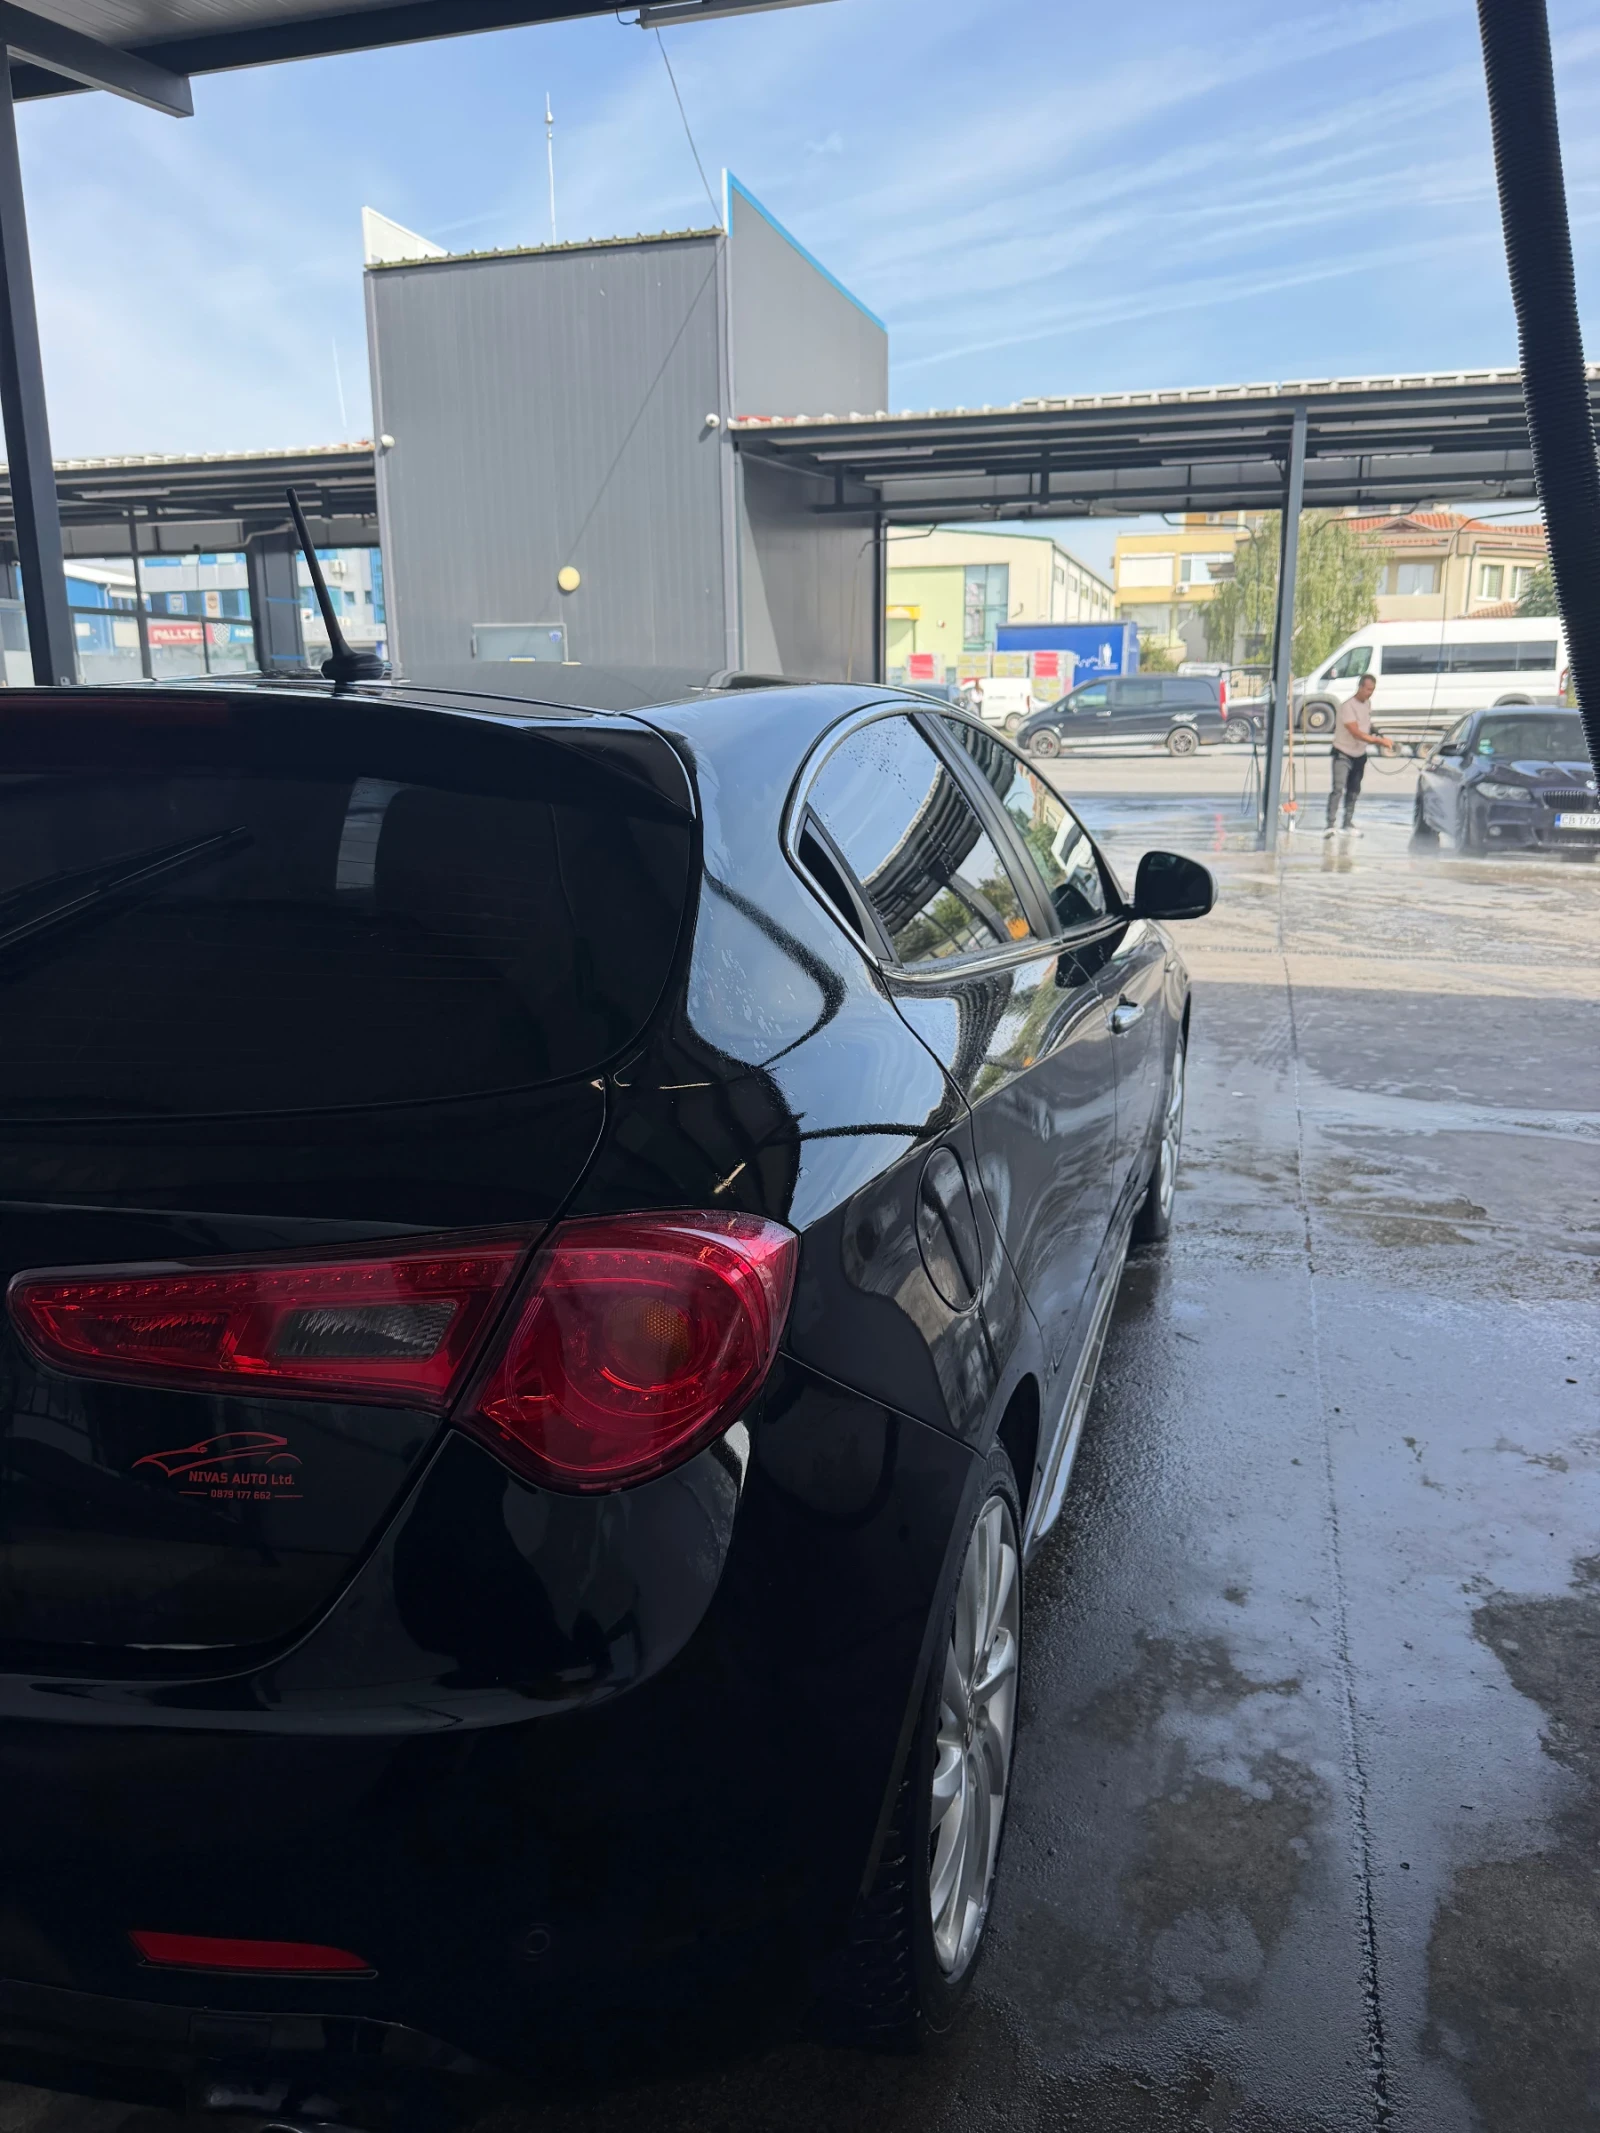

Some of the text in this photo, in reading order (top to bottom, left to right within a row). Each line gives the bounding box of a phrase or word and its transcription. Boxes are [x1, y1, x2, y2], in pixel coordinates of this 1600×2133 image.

[188, 1471, 295, 1485] NIVAS AUTO Ltd.
[210, 1489, 271, 1500] 0879 177 662
